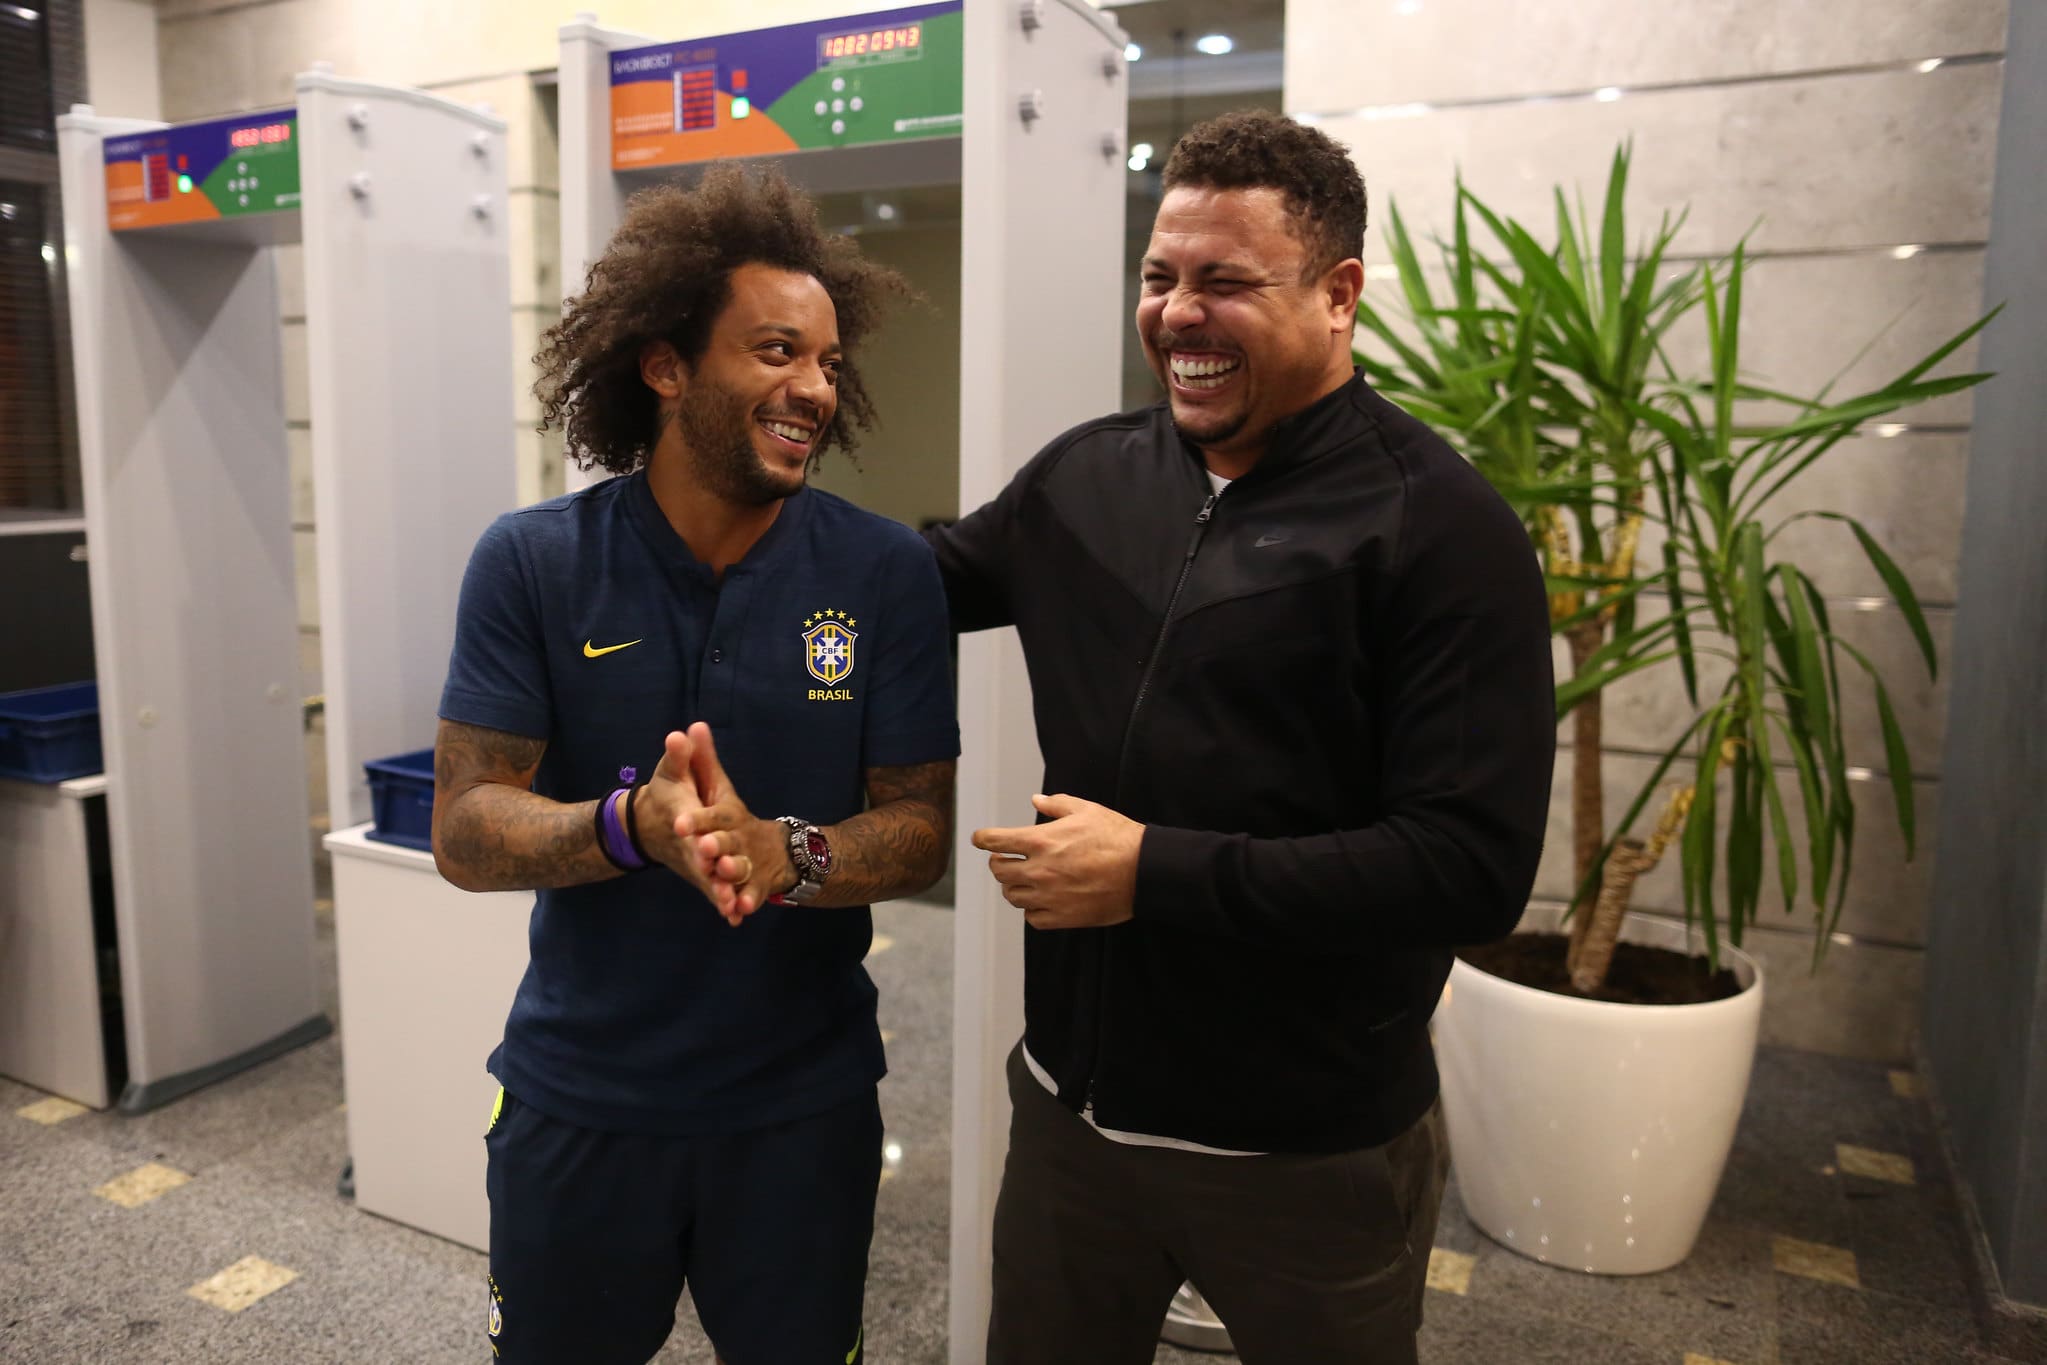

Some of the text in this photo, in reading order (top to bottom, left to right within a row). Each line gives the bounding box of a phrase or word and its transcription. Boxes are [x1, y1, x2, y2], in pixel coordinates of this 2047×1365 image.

[870, 25, 920, 52] 0943
[821, 647, 839, 655] CBF
[808, 689, 854, 701] BRASIL
